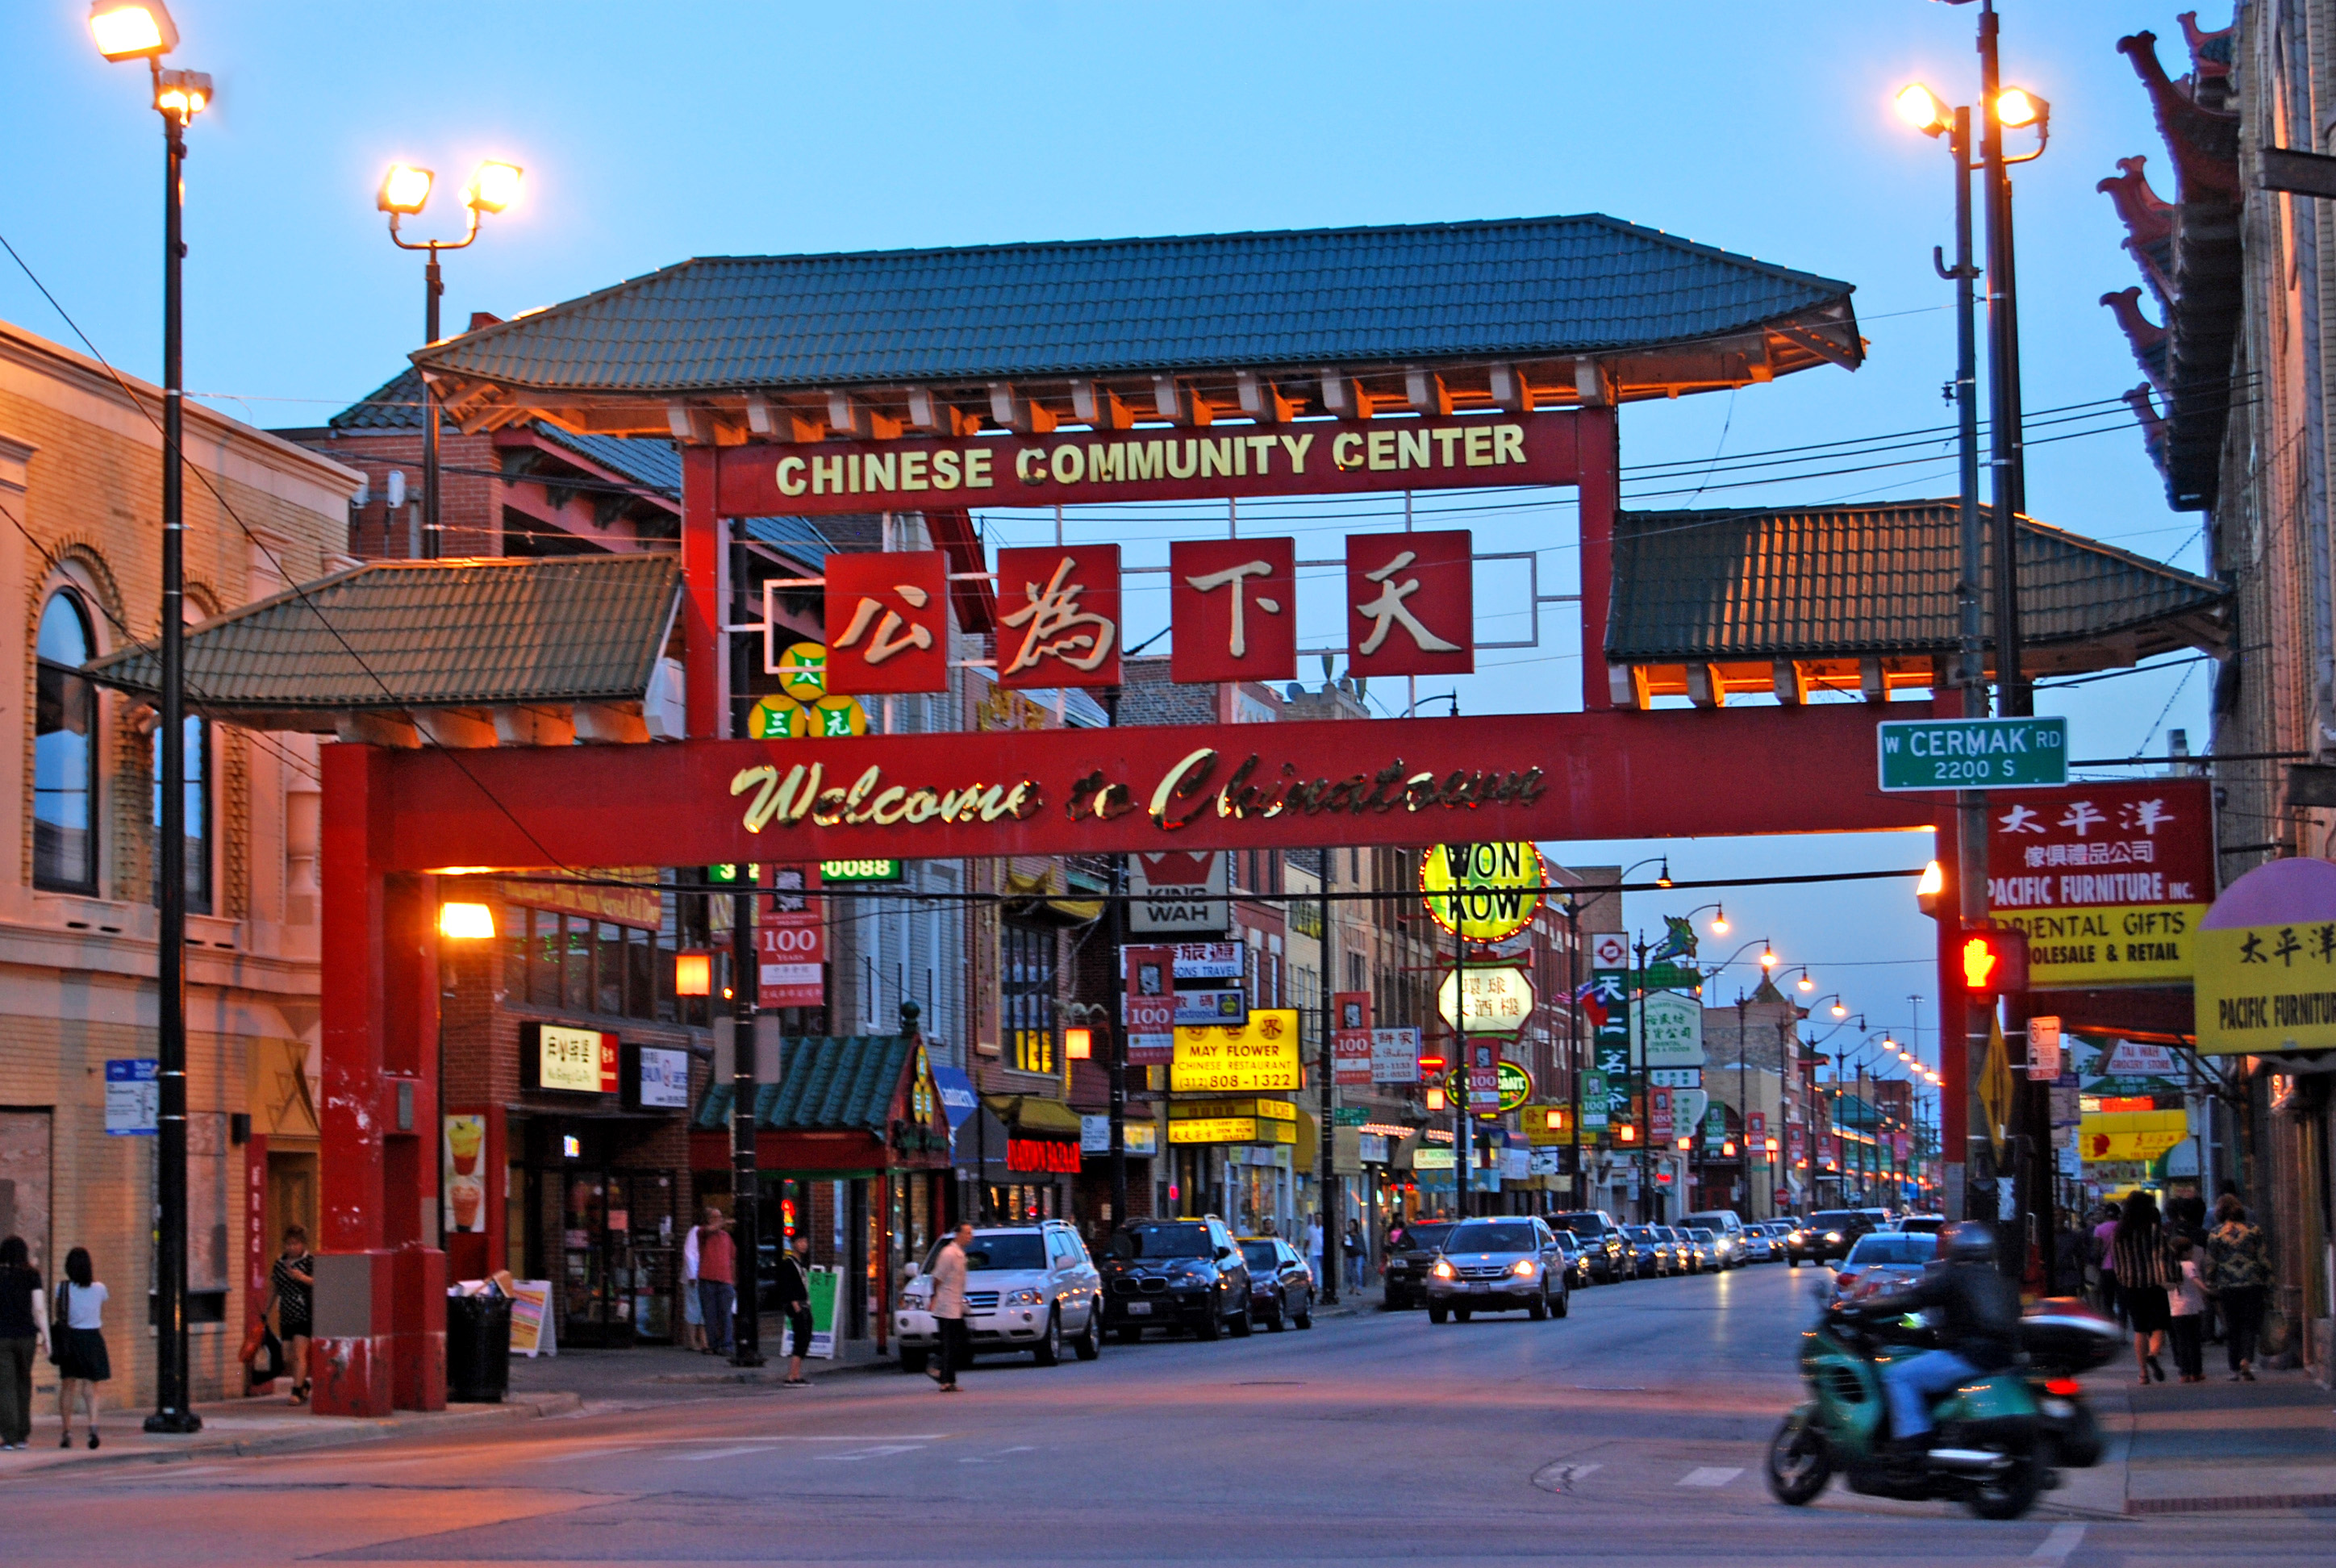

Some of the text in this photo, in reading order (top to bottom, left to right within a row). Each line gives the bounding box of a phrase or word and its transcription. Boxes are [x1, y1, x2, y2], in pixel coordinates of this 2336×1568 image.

[776, 423, 1527, 497] CHINESE COMMUNITY CENTER
[1885, 728, 2061, 757] W CERMAK RD
[1934, 759, 2015, 779] 2200 S
[729, 746, 1548, 835] Welcome to Chinatown
[1998, 798, 2175, 836] 太平洋
[1443, 841, 1520, 878] WON
[2060, 872, 2163, 904] FURNITURE
[2169, 882, 2195, 899] INC.
[1447, 886, 1522, 921] KOW
[1147, 906, 1208, 922] WAH
[2123, 911, 2186, 936] GIFTS
[764, 930, 816, 952] 100
[2106, 945, 2119, 961] &
[2127, 942, 2180, 961] RETAIL
[1202, 965, 1237, 977] TRAVEL
[1131, 1008, 1170, 1024] 100
[2219, 995, 2268, 1030] PACIFIC
[1189, 1045, 1280, 1057] MAY FLOWER
[1339, 1038, 1369, 1052] 100
[1177, 1061, 1291, 1071] CHINESE RESTAURANT
[1470, 1075, 1496, 1086] 100
[1583, 1101, 1605, 1111] 100
[1653, 1115, 1671, 1124] 100
